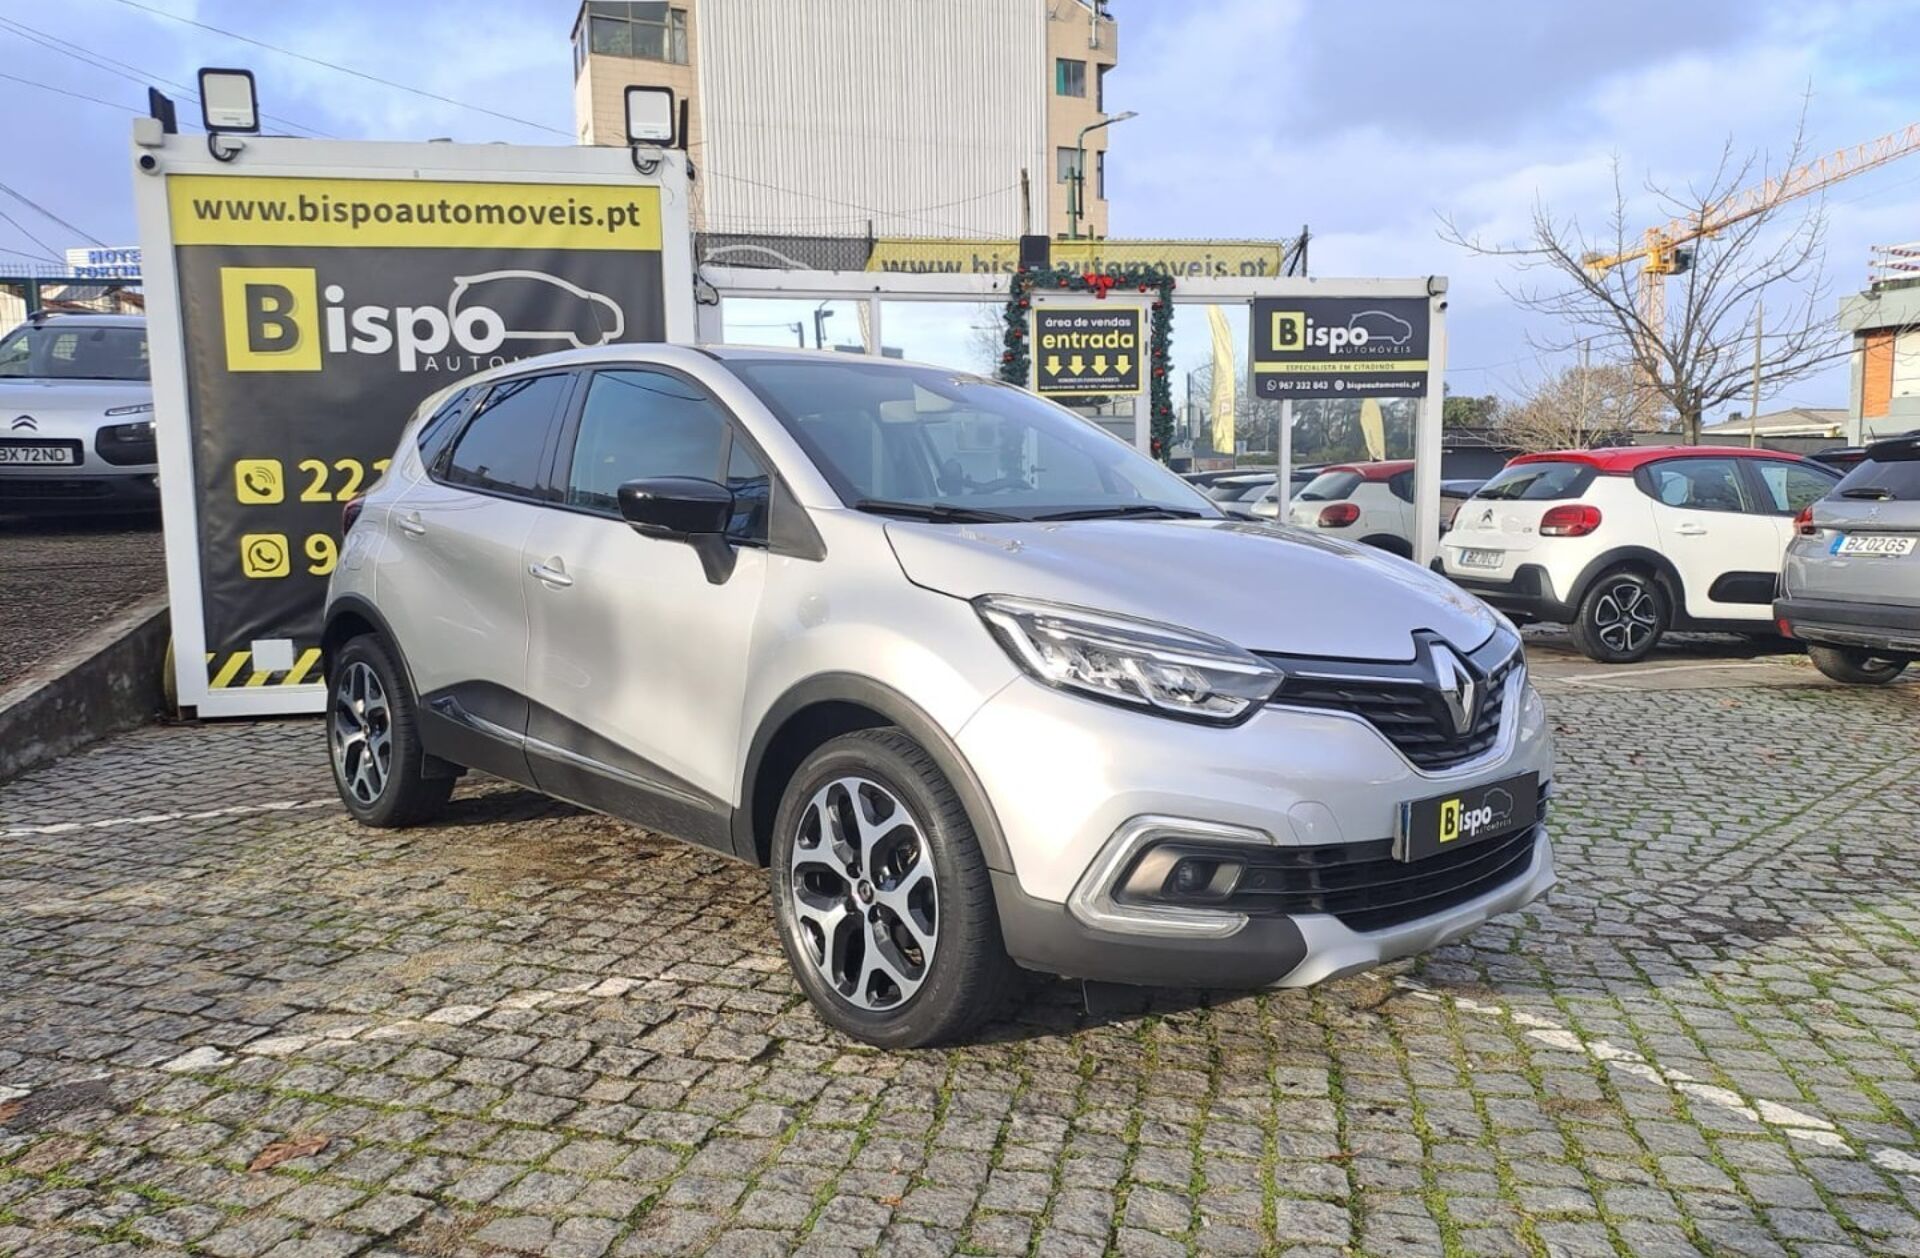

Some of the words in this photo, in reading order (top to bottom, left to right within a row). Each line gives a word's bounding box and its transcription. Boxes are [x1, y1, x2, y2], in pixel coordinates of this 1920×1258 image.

[193, 194, 640, 233] www.bispoautomoveis.pt
[245, 284, 506, 372] Bispo
[1045, 317, 1072, 327] área
[1074, 317, 1088, 327] de
[1091, 317, 1132, 327] vendas
[1042, 329, 1134, 349] entrada
[1279, 317, 1369, 354] Bispo
[424, 355, 530, 372] AUTO
[1845, 537, 1908, 553] BZ02GS
[1444, 803, 1492, 836] Bispo
